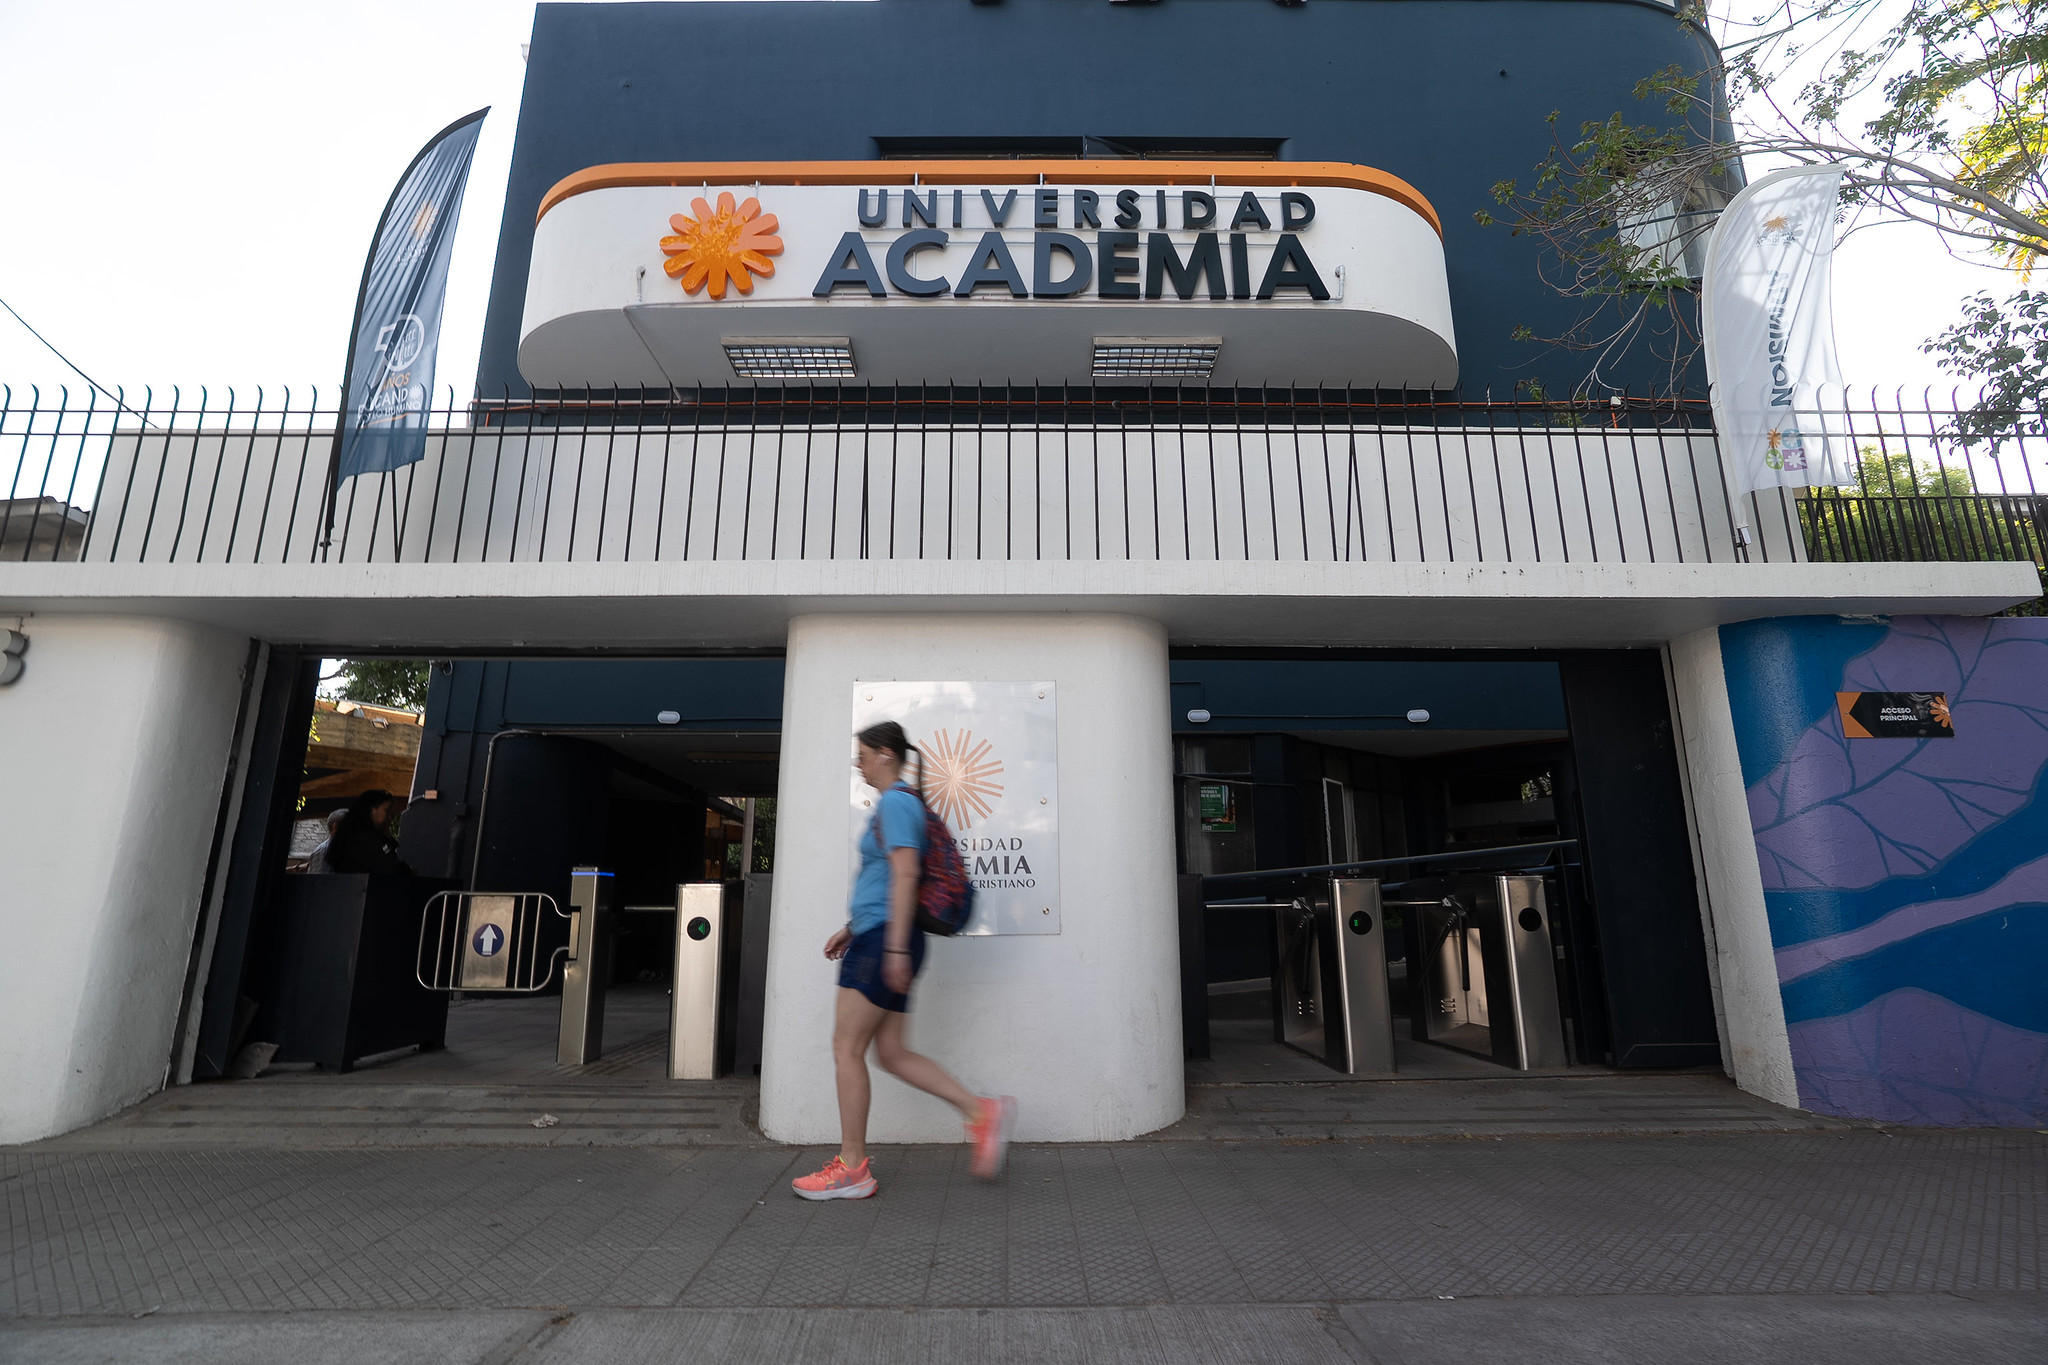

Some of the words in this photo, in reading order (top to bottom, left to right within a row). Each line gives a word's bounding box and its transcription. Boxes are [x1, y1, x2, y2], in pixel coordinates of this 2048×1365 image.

[858, 188, 1316, 231] UNIVERSIDAD
[812, 229, 1331, 301] ACADEMIA
[962, 855, 1032, 875] EMIA
[970, 878, 1036, 889] CRISTIANO
